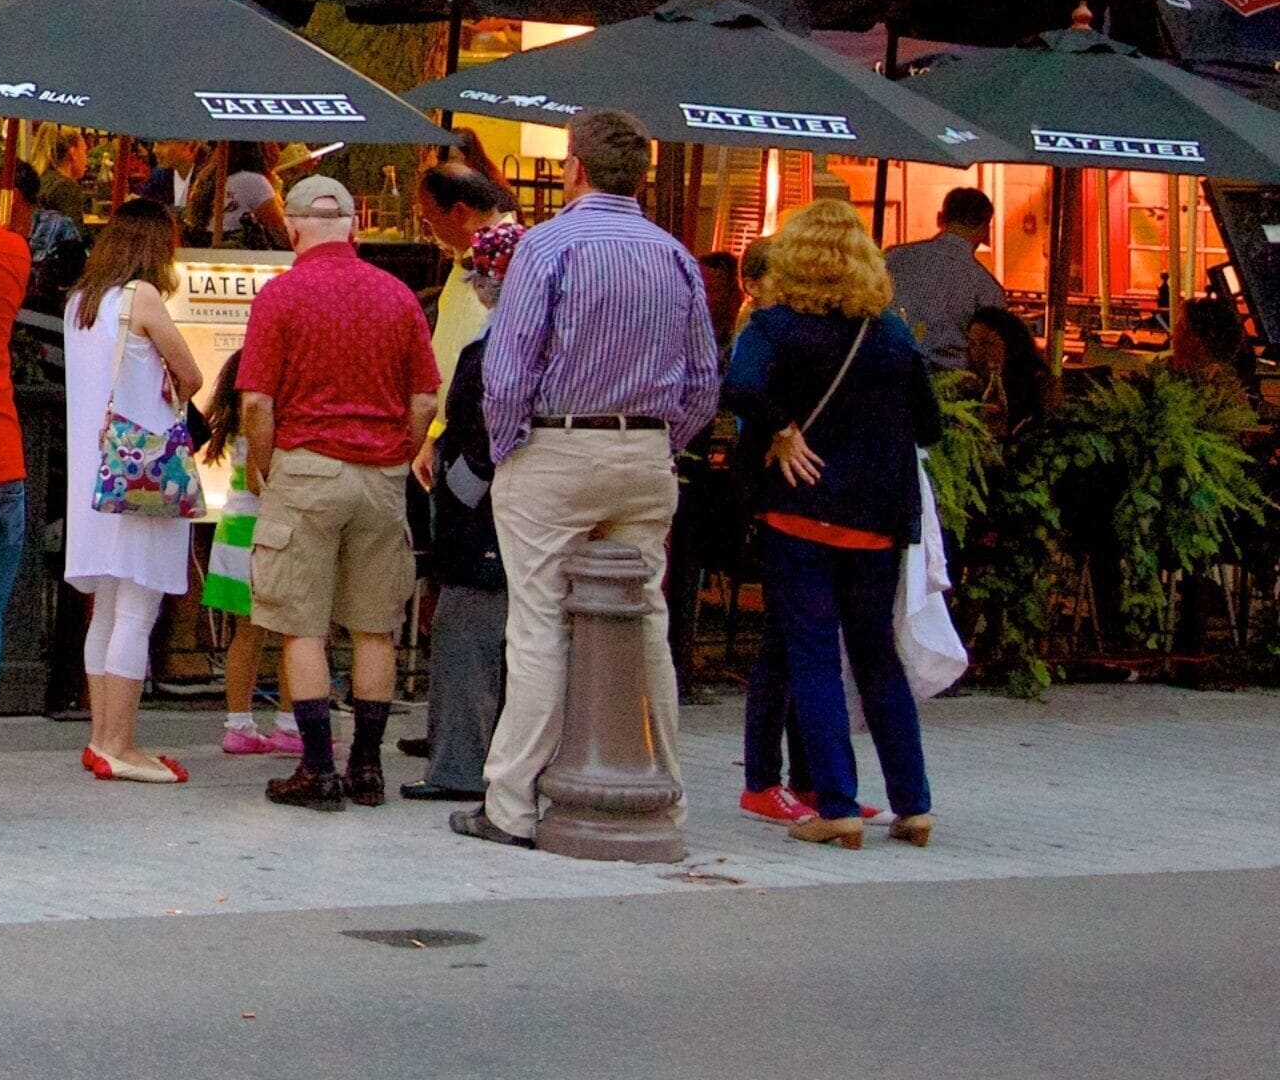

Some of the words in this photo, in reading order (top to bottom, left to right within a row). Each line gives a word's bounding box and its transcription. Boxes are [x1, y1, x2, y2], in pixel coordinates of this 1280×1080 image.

[38, 90, 90, 107] BLANC
[200, 98, 359, 115] L'ATELIER
[683, 107, 851, 134] L'ATELIER
[1034, 134, 1201, 158] L'ATELIER
[188, 275, 260, 296] L'ATEL
